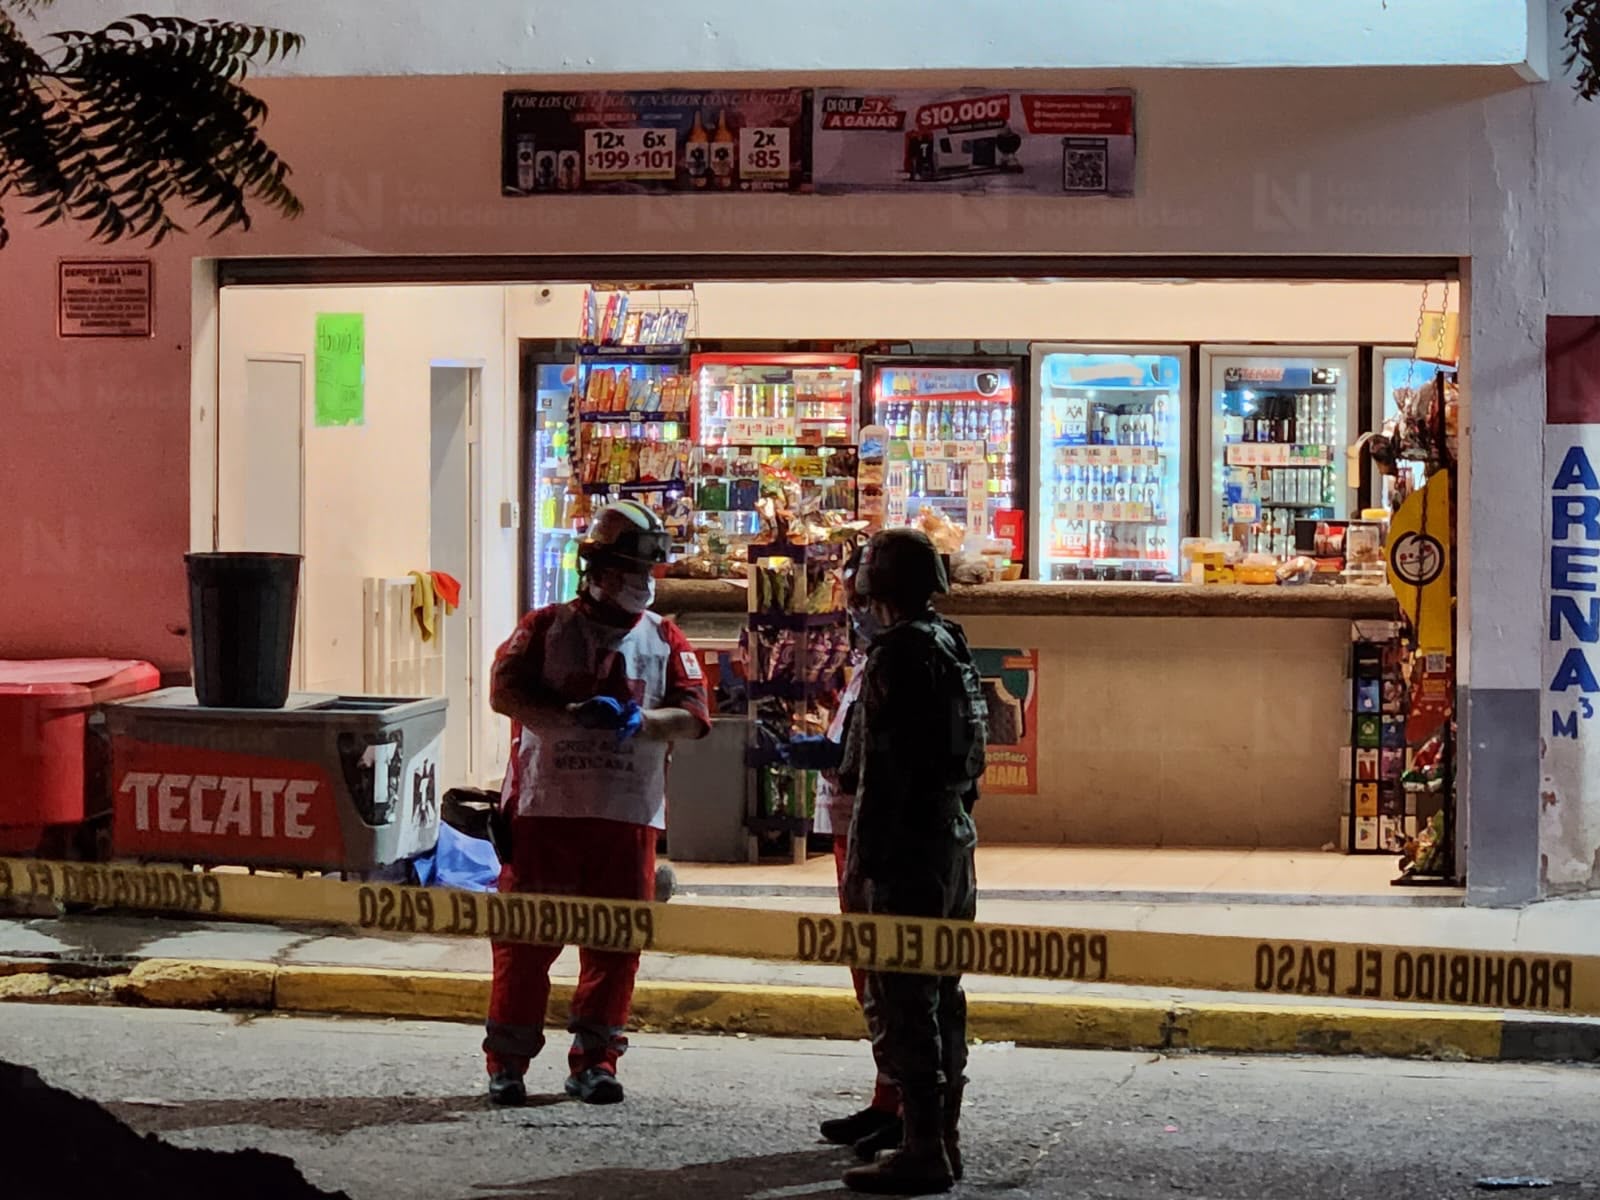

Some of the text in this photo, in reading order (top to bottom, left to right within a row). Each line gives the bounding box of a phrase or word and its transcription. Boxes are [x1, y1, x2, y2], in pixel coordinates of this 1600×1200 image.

[830, 114, 898, 127] A GANAR
[920, 99, 1001, 126] $10,000
[592, 131, 666, 148] 12x 6x
[752, 130, 776, 148] 2x
[588, 150, 674, 169] $199 $101
[748, 150, 781, 169] $85
[1549, 445, 1600, 693] ARENA
[118, 771, 320, 839] TECATE
